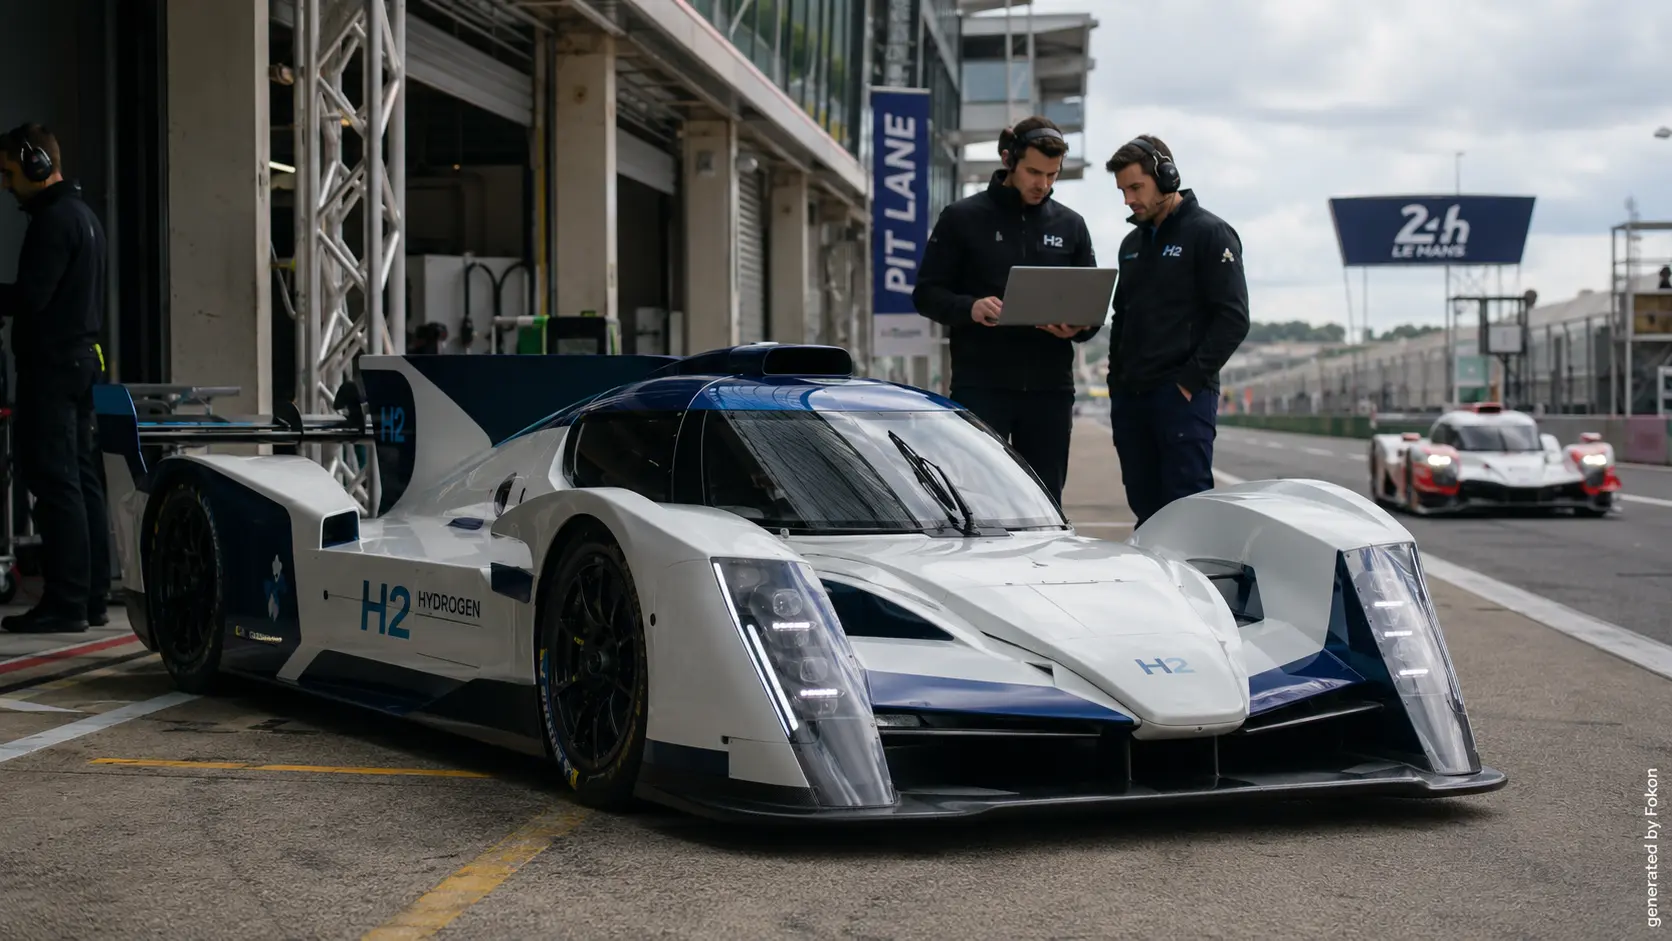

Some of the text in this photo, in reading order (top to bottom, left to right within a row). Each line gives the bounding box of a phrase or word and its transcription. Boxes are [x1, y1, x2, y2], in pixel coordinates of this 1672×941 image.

[884, 112, 917, 223] LANE
[1043, 234, 1064, 248] H2
[1162, 244, 1182, 257] H2
[1391, 244, 1467, 258] LE MANS
[884, 229, 917, 295] PIT
[381, 406, 406, 443] H2
[361, 580, 481, 640] H2 HYDROGEN
[1134, 657, 1197, 675] H2
